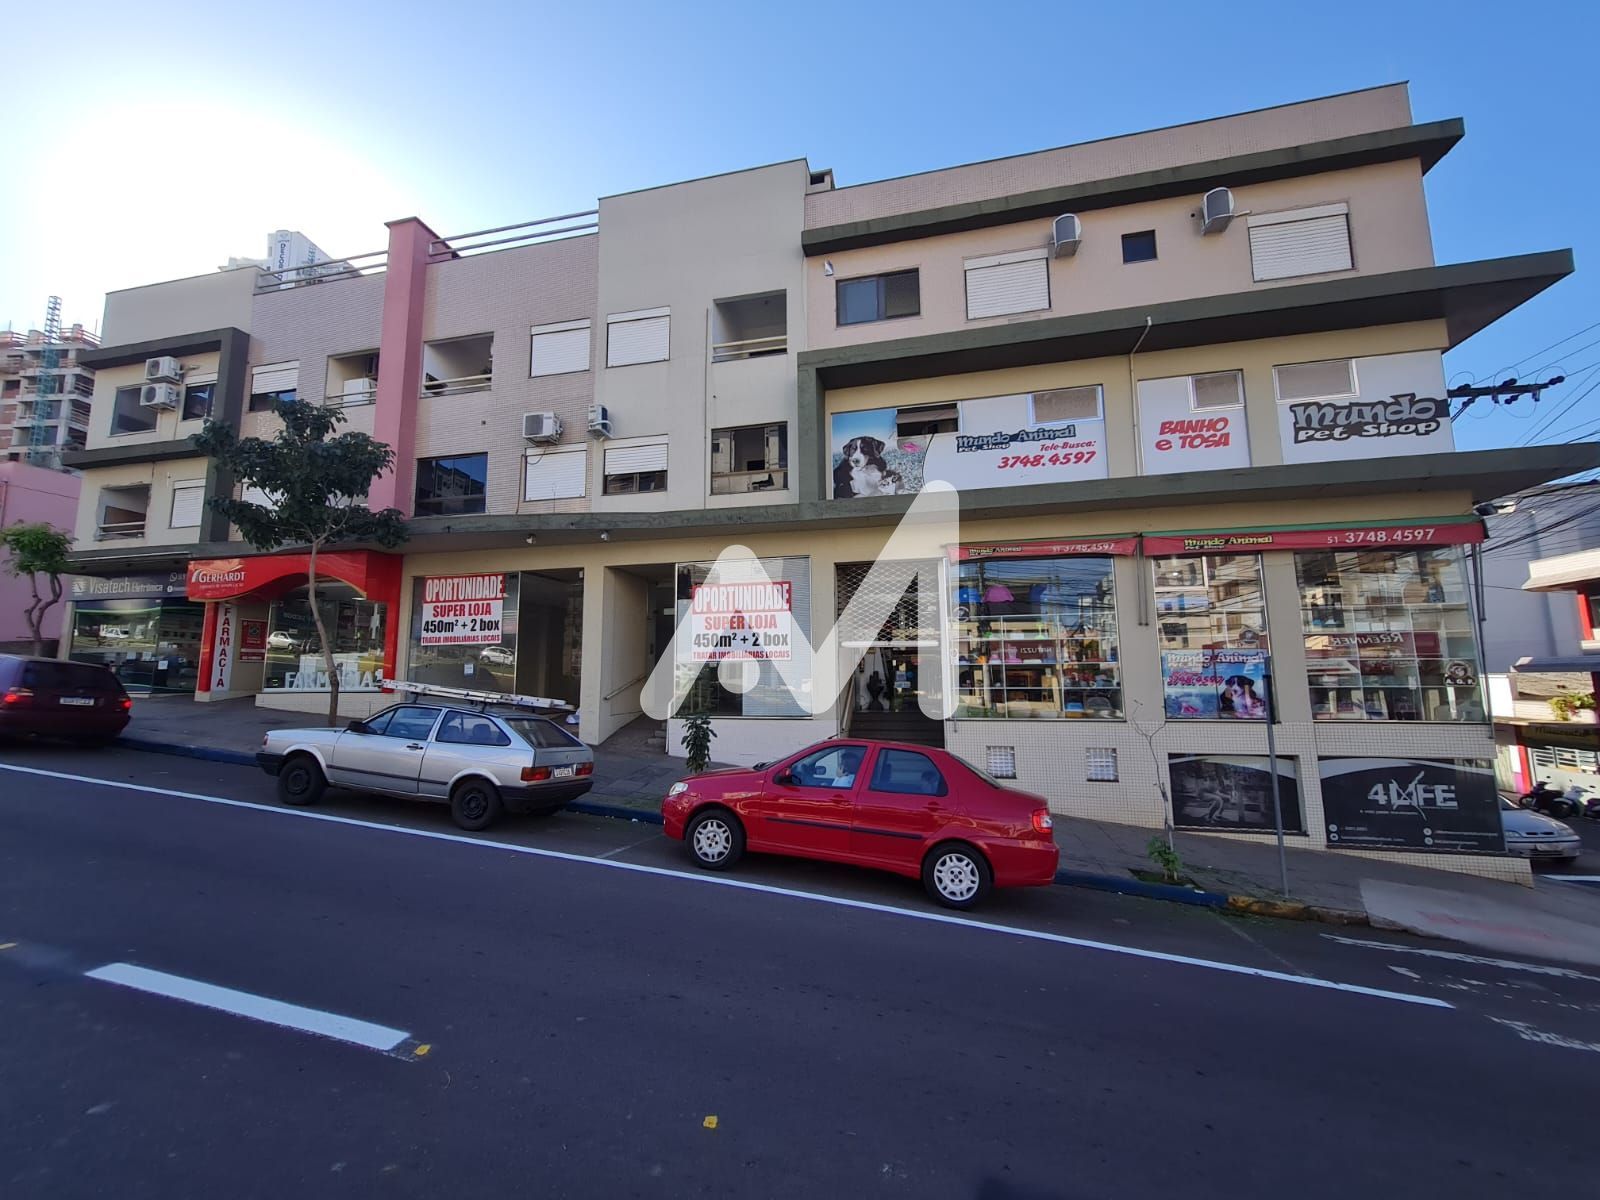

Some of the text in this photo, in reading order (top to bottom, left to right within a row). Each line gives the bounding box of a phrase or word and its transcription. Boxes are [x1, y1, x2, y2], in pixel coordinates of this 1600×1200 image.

[1016, 424, 1077, 442] Animal
[1158, 416, 1229, 436] BANHO
[1297, 420, 1439, 442] Pet Shop
[1155, 432, 1230, 451] e TOSA
[997, 450, 1097, 470] 3748.4597
[1228, 535, 1273, 545] Animal
[1327, 527, 1436, 544] 51 3748.4597
[89, 576, 130, 594] Visatech
[198, 570, 247, 583] GERHARDT
[425, 575, 504, 602] OPORTUNIDADE
[694, 583, 790, 612] OPORTUNIDADE
[432, 602, 492, 618] SUPER LOJA
[423, 619, 459, 633] 450m²
[470, 619, 477, 631] 2
[479, 618, 500, 632] box
[704, 614, 777, 631] SUPER LOJA
[216, 607, 232, 688] FARMACIA
[751, 631, 761, 646] 2
[763, 631, 789, 647] box
